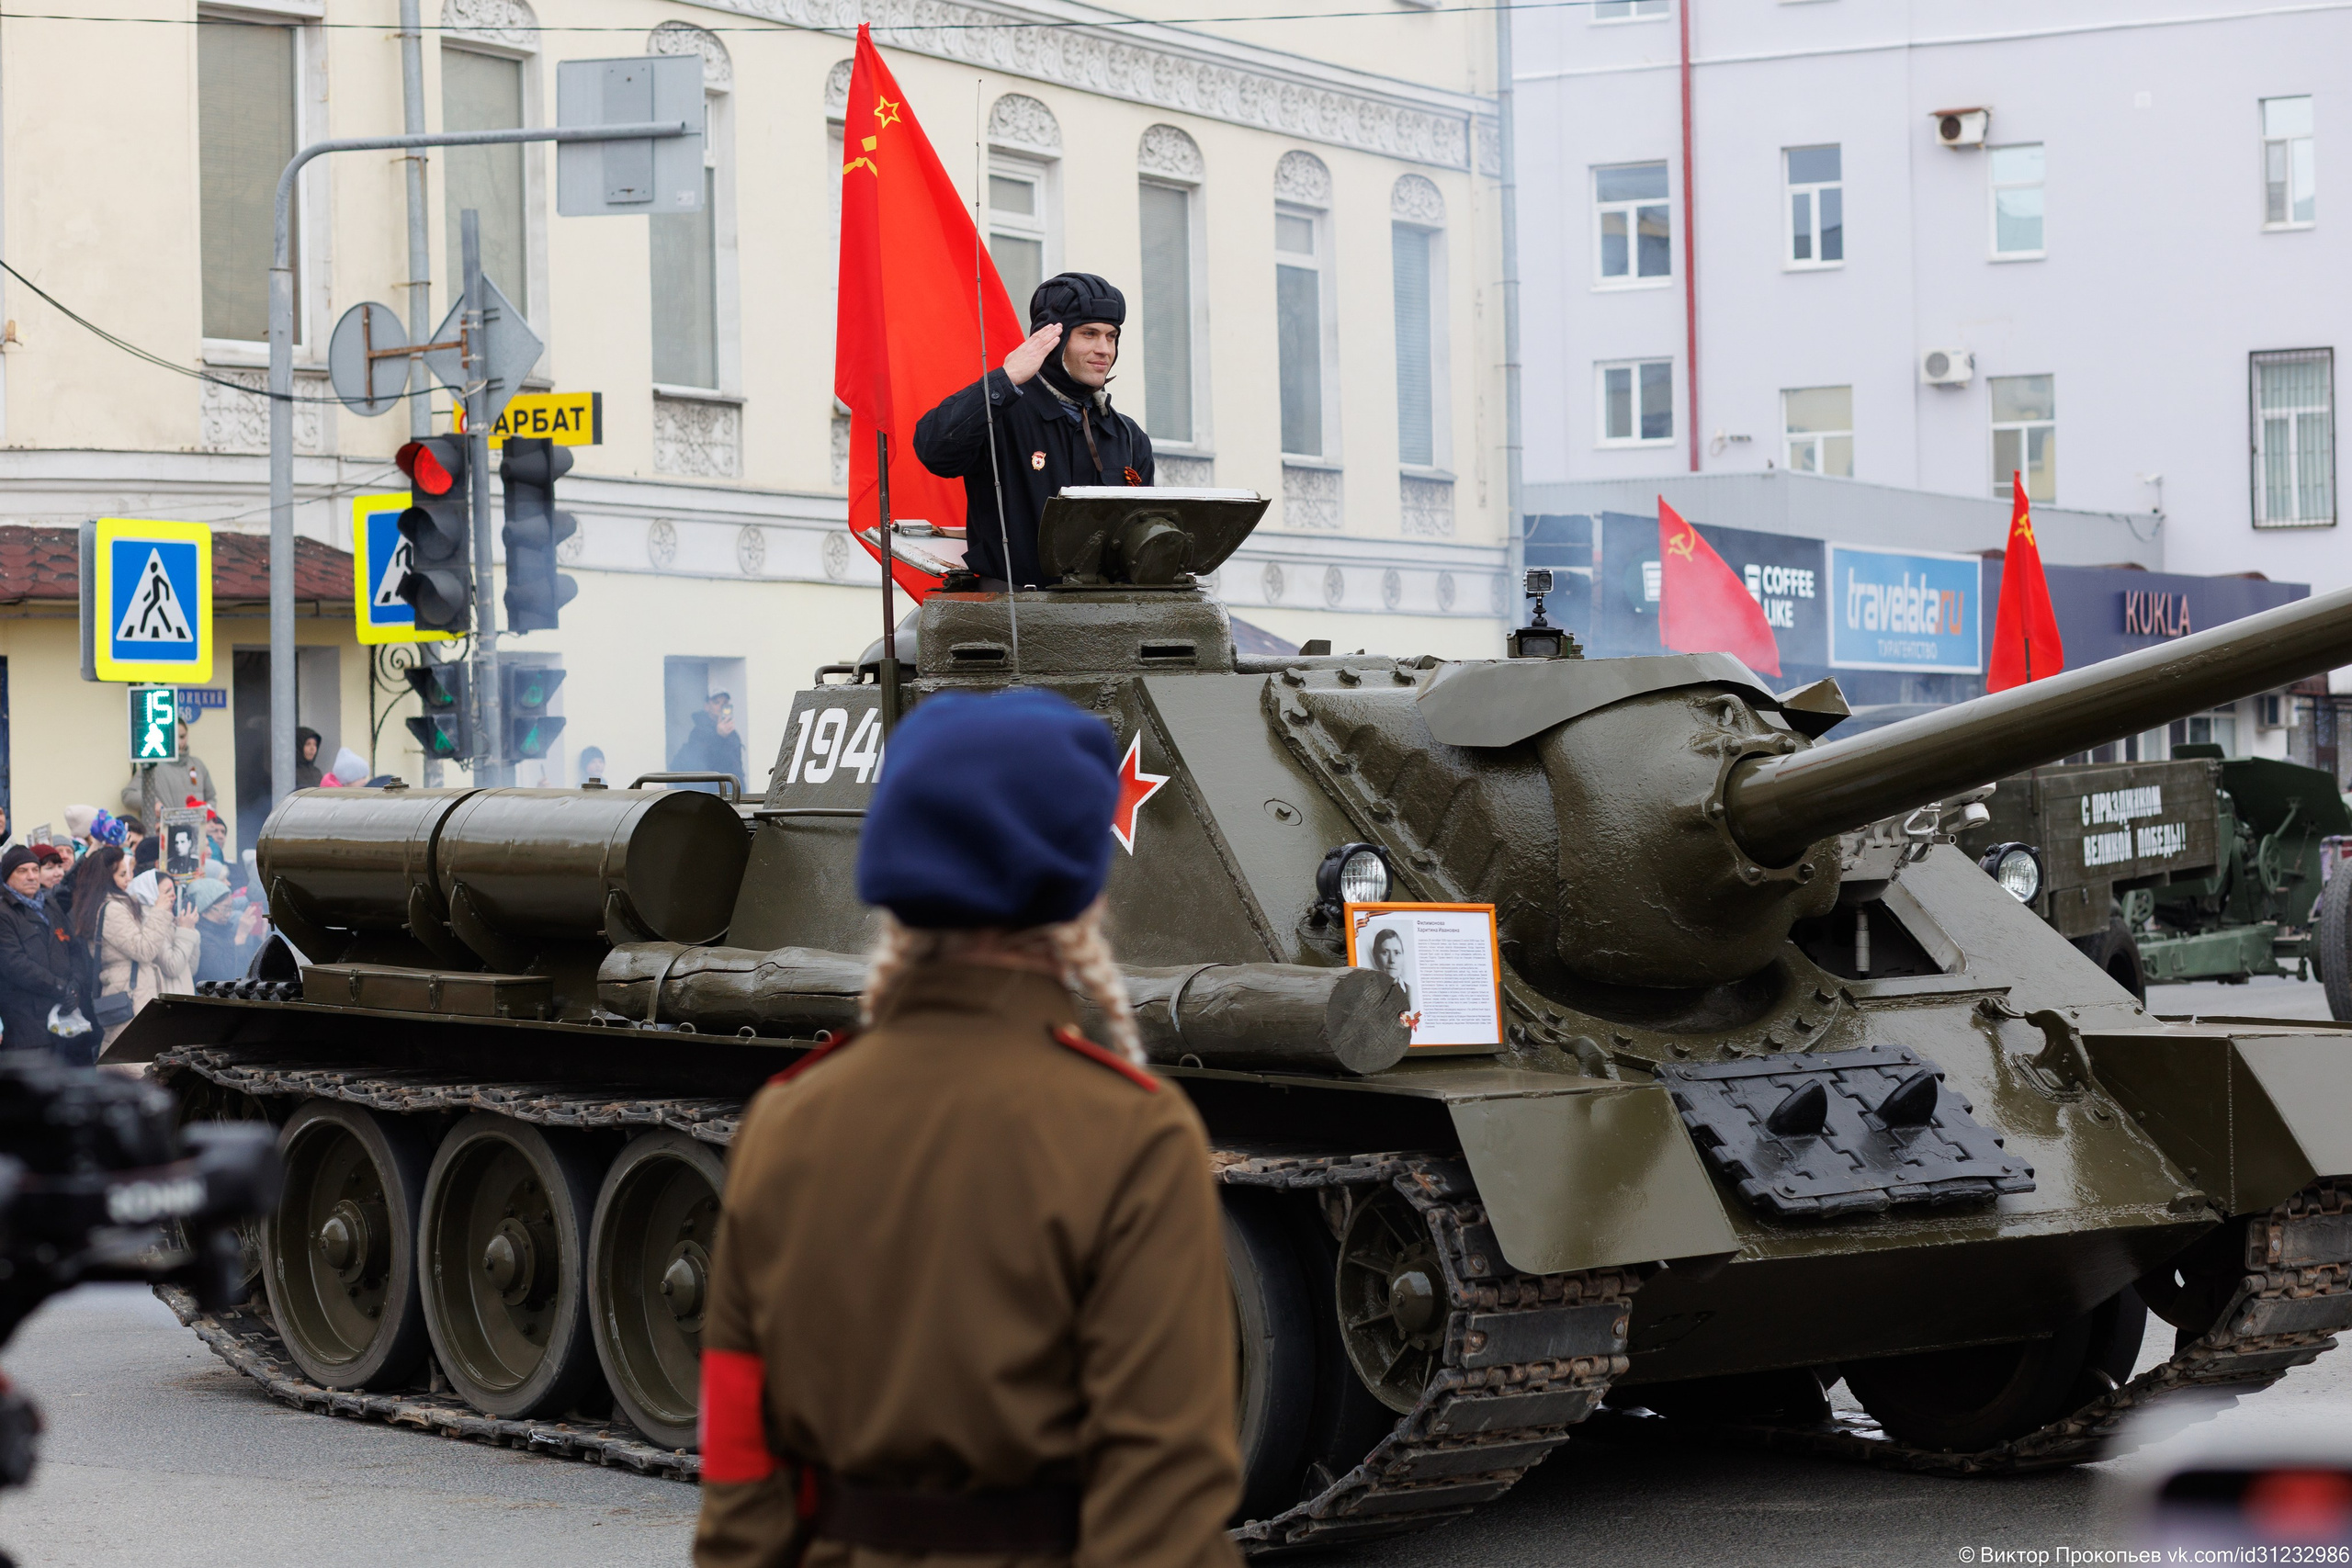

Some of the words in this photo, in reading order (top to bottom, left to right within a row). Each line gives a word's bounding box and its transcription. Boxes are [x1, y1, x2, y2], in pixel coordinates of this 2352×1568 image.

[1762, 565, 1815, 599] COFFEE
[1847, 567, 1964, 636] travelata.ru
[1763, 598, 1794, 628] LIKE
[2125, 590, 2191, 637] KUKLA
[146, 690, 173, 725] 15
[178, 691, 223, 705] ОИЦКИЙ
[786, 707, 885, 784] 194
[2081, 795, 2090, 827] С
[2092, 785, 2162, 826] ПРАЗДНИКОМ
[2083, 824, 2133, 867] ВЕЛИКОЙ
[2137, 822, 2186, 859] ПОБЕДЫ!
